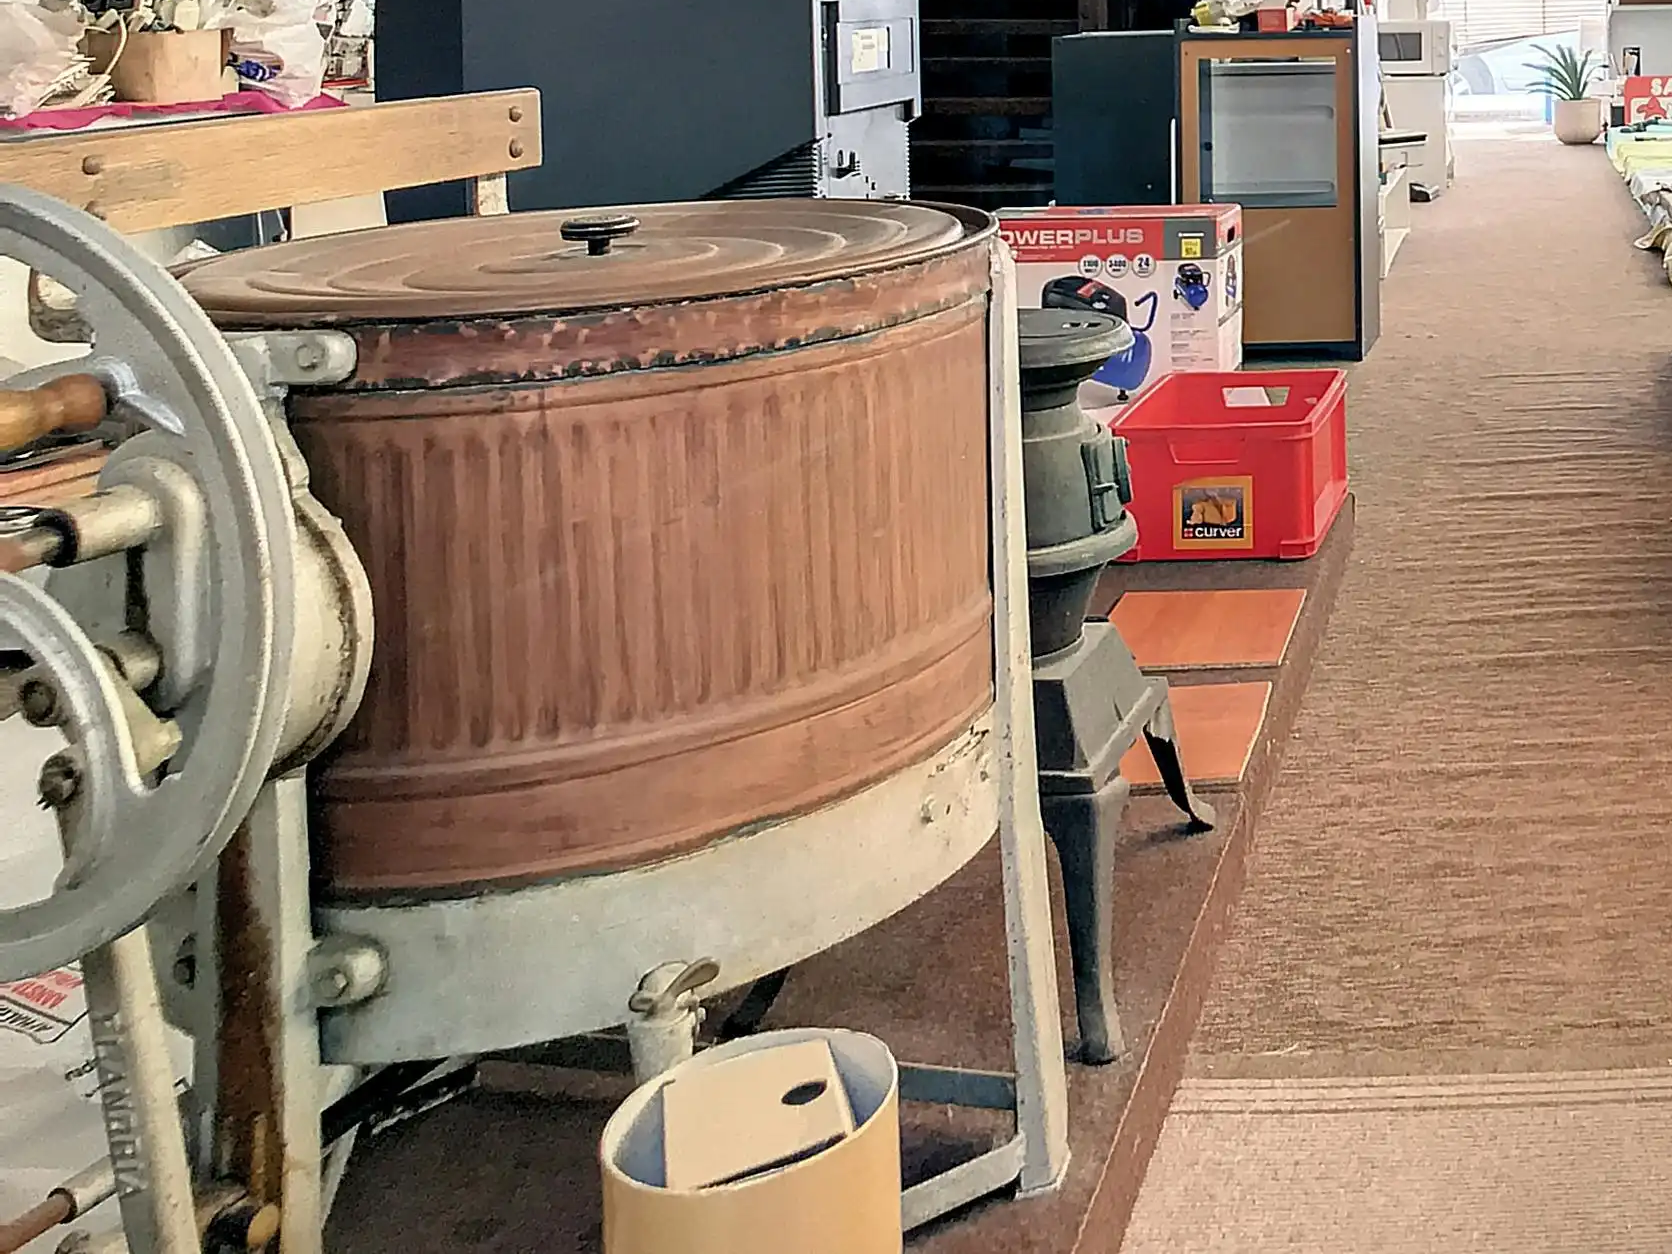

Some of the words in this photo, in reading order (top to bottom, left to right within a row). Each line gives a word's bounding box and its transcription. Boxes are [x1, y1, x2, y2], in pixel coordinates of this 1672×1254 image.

[1000, 227, 1144, 245] OWERPLUS
[1137, 257, 1150, 268] 24
[1194, 527, 1242, 537] curver
